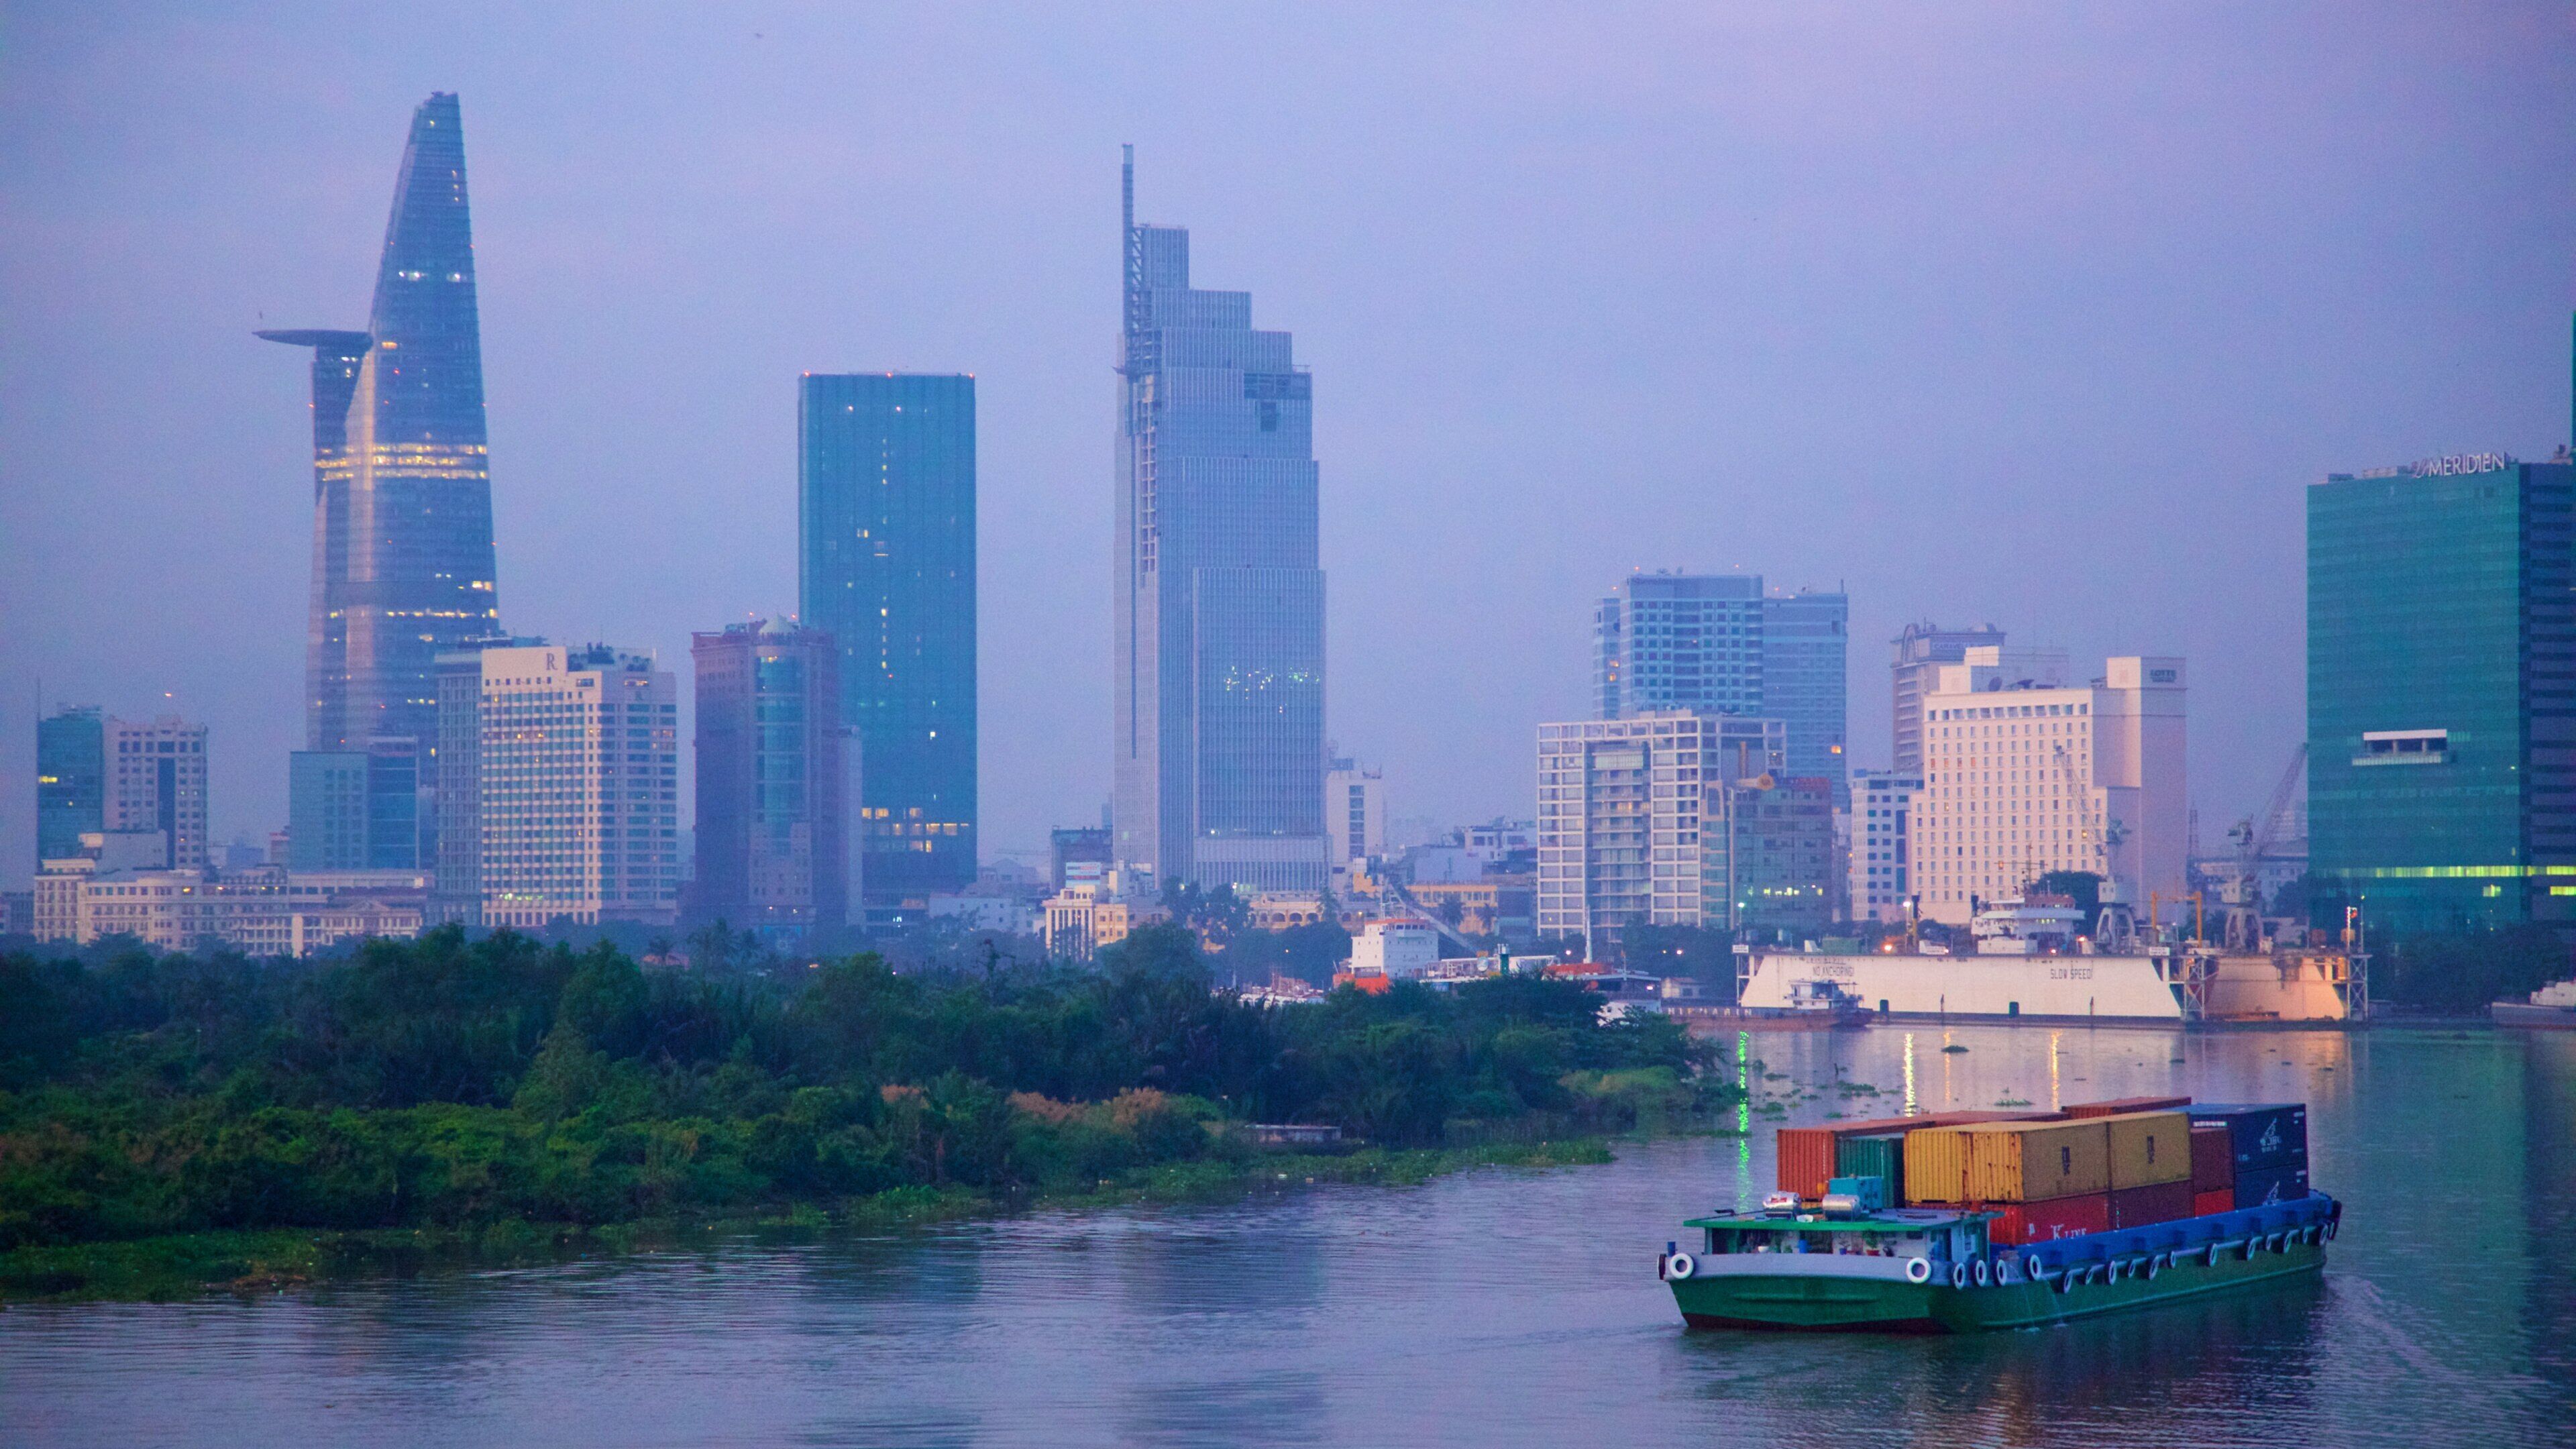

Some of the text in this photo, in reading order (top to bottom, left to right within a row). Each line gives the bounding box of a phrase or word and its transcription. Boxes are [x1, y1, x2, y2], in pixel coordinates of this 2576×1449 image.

[2428, 452, 2505, 477] MERIDIEN
[546, 653, 558, 670] R
[2050, 969, 2068, 979] SLOW
